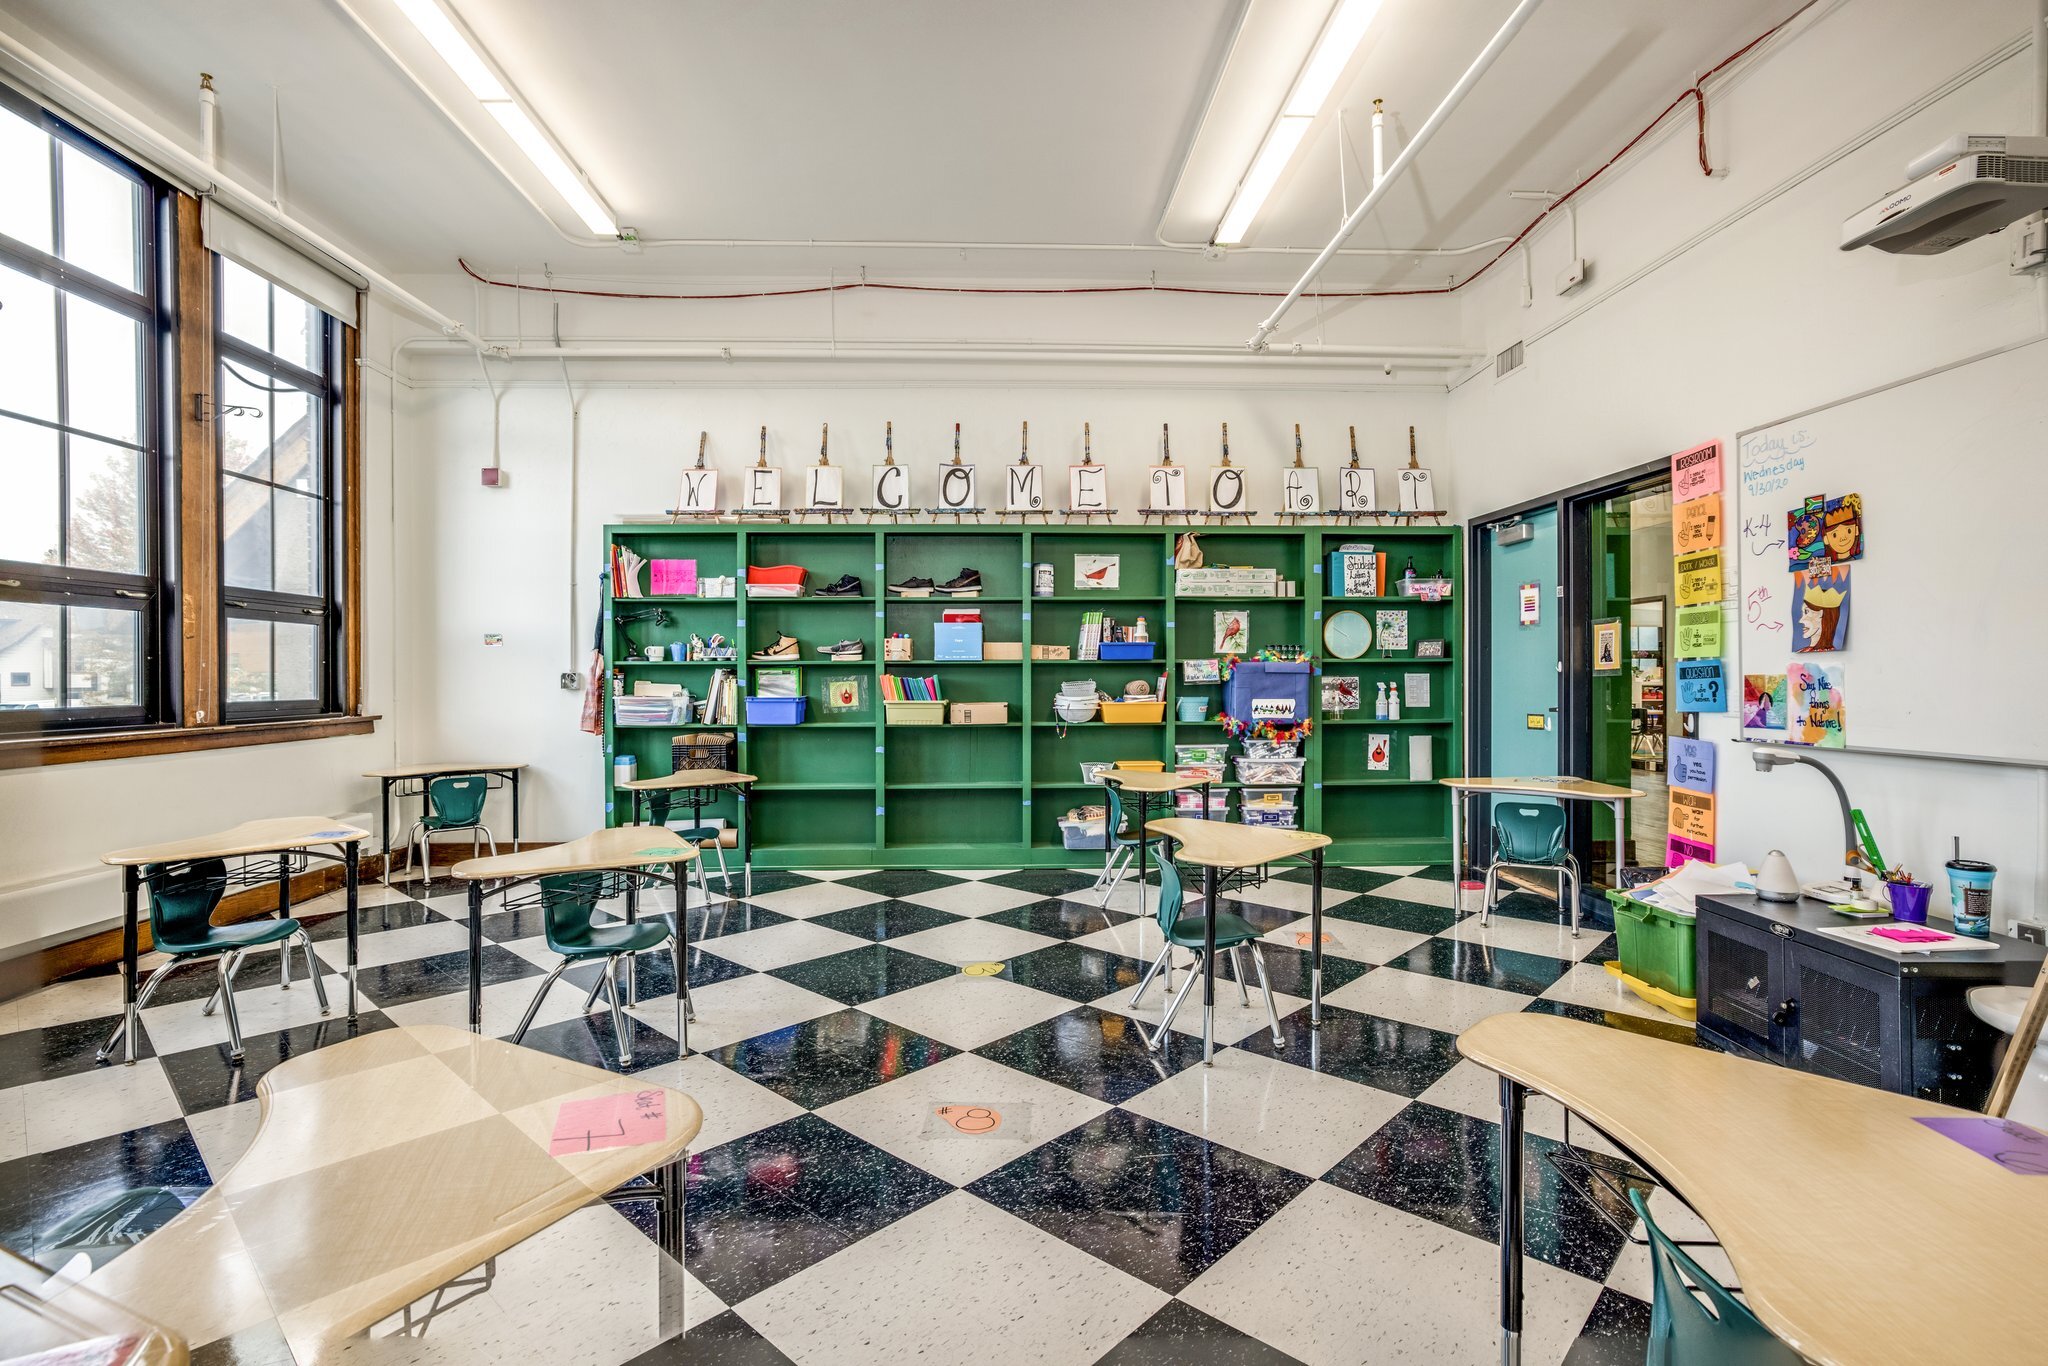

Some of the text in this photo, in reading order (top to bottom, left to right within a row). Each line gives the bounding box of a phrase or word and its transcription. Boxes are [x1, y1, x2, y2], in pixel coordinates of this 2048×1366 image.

[1743, 434, 1788, 459] Today
[1744, 458, 1805, 483] Wednesday
[1748, 478, 1789, 496] 9/30/20
[1744, 514, 1771, 538] K-4
[1748, 586, 1771, 623] 5th
[1799, 673, 1833, 698] Say Nice
[1809, 697, 1830, 714] things
[1796, 711, 1843, 733] to Nature!
[1683, 844, 1694, 857] NO
